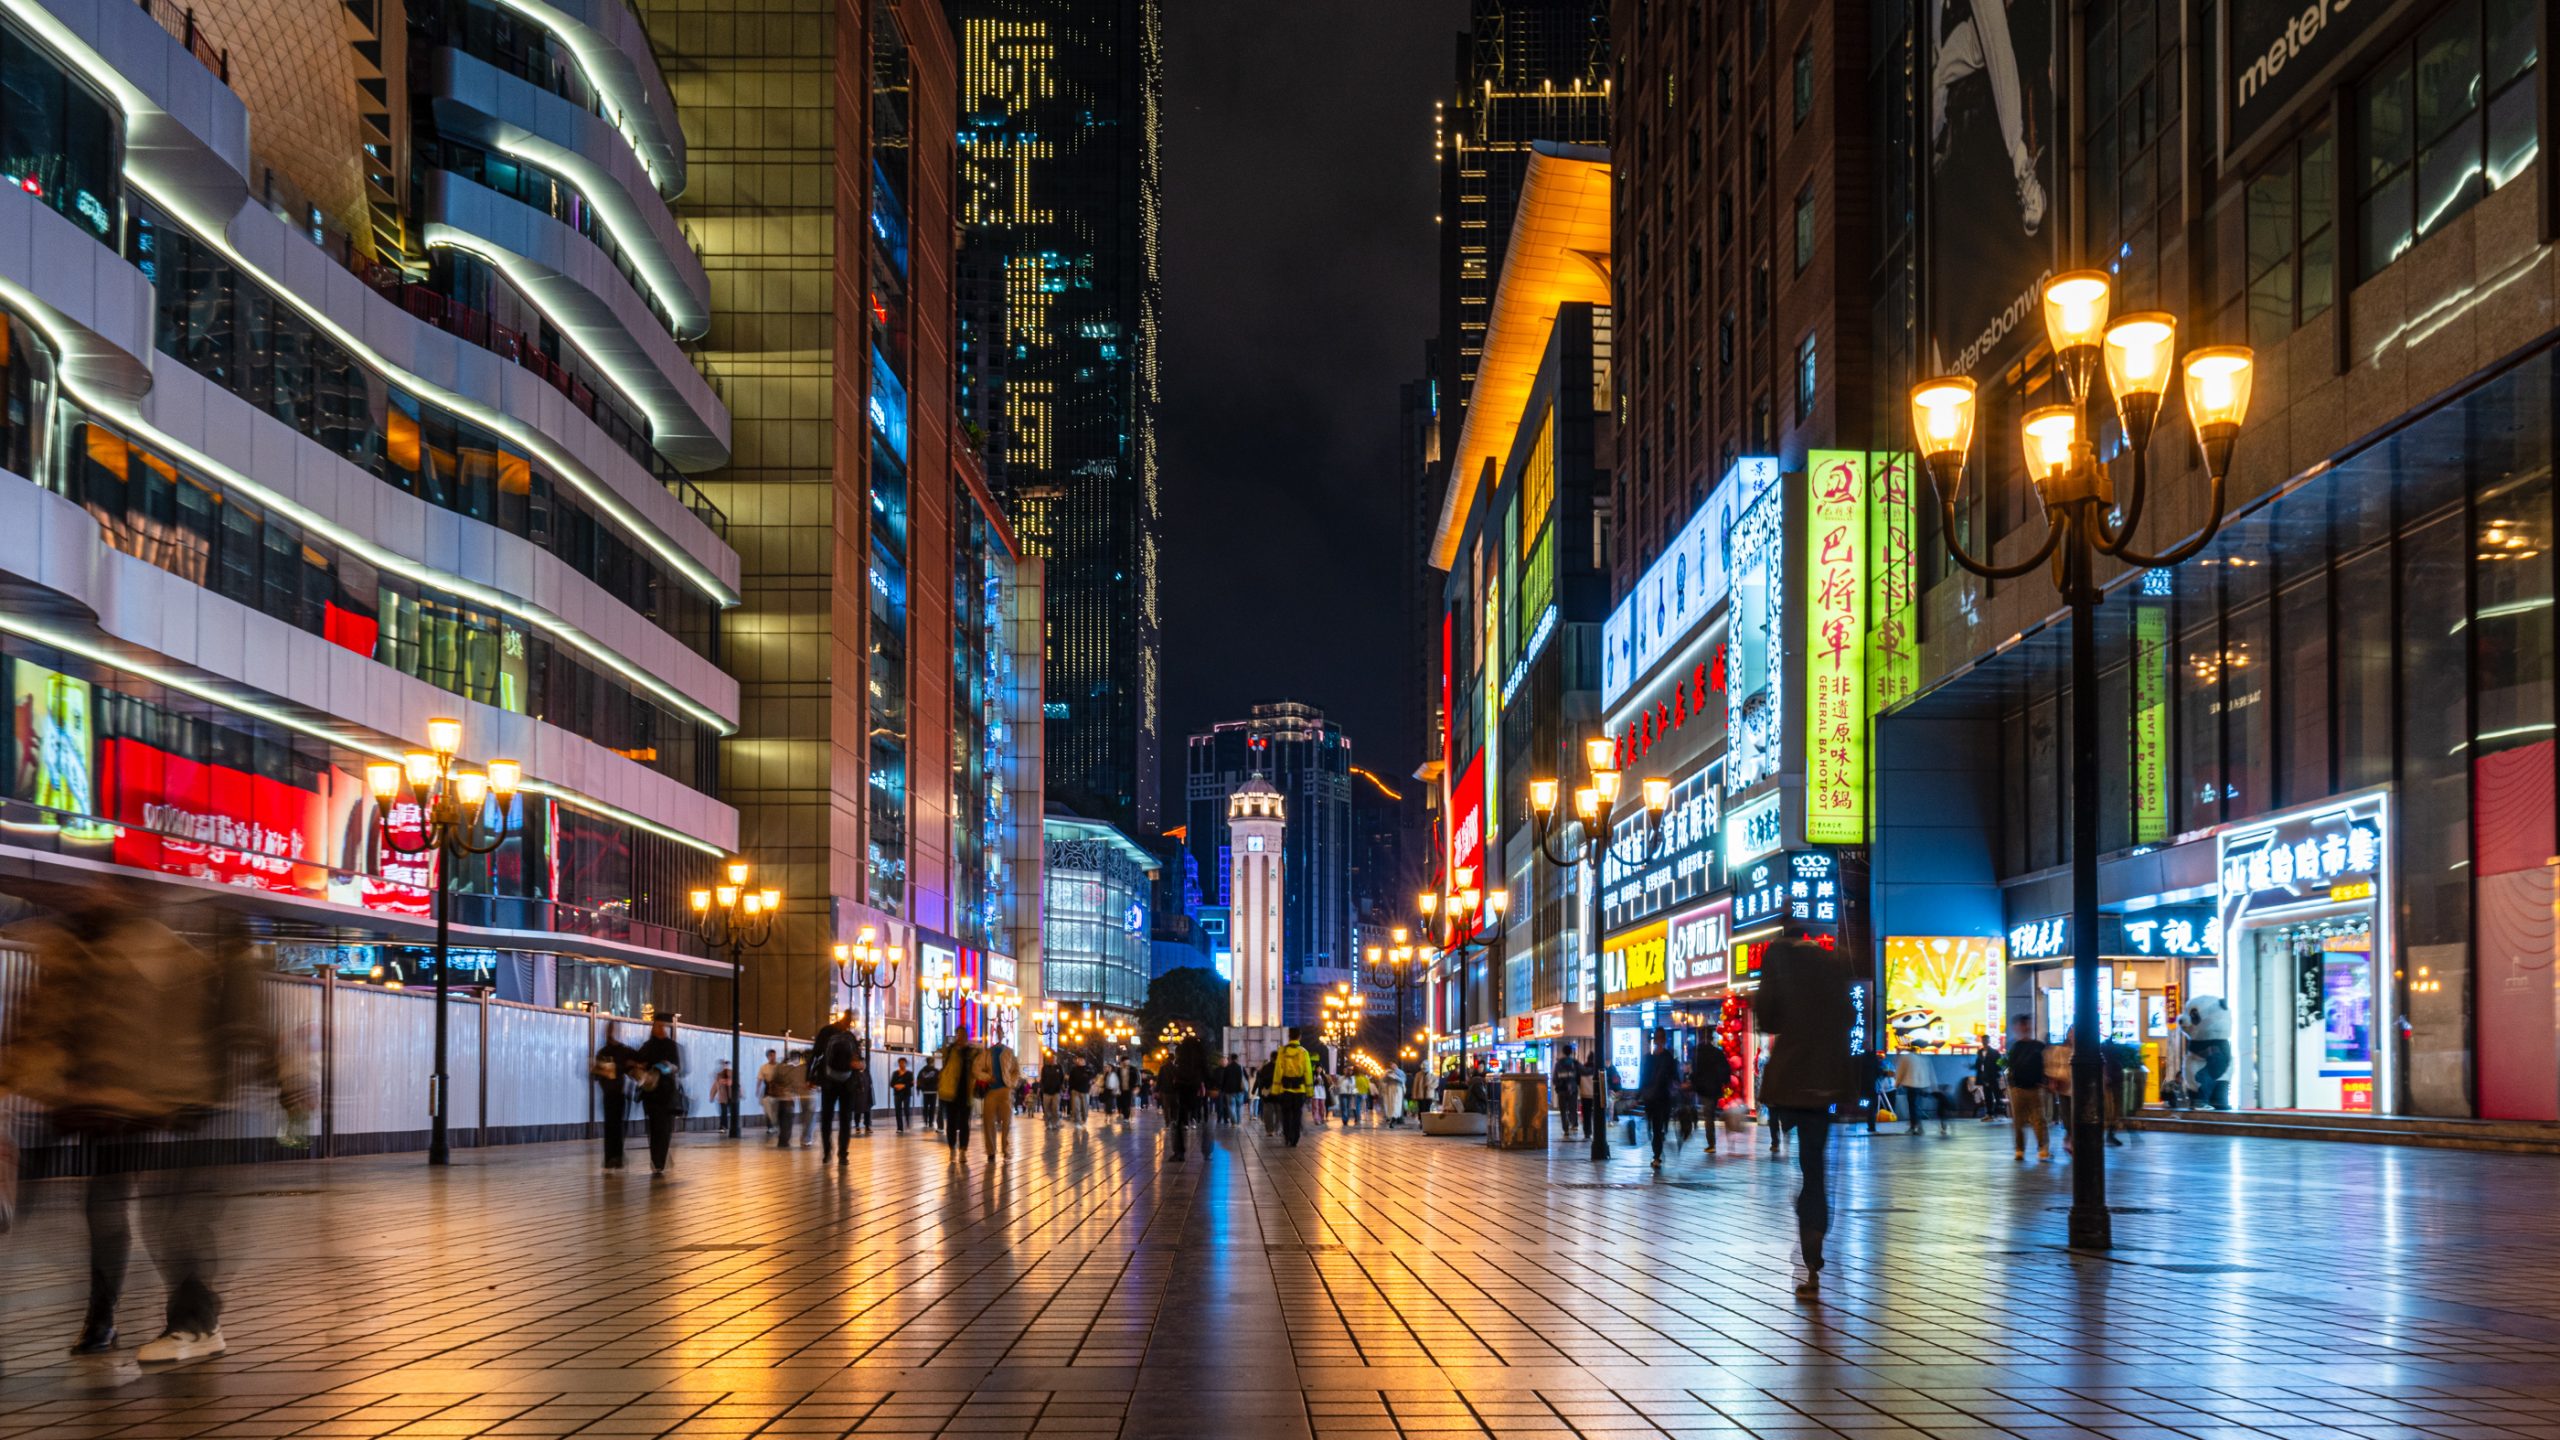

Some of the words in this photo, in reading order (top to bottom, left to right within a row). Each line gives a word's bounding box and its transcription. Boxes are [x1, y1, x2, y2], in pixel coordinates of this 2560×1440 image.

[1819, 675, 1828, 733] GENERAL
[1819, 738, 1828, 754] BA
[1819, 760, 1828, 810] HOTPOT
[1791, 881, 1835, 898] 希岸
[1791, 901, 1835, 919] 酒店
[1603, 948, 1626, 994] HLA
